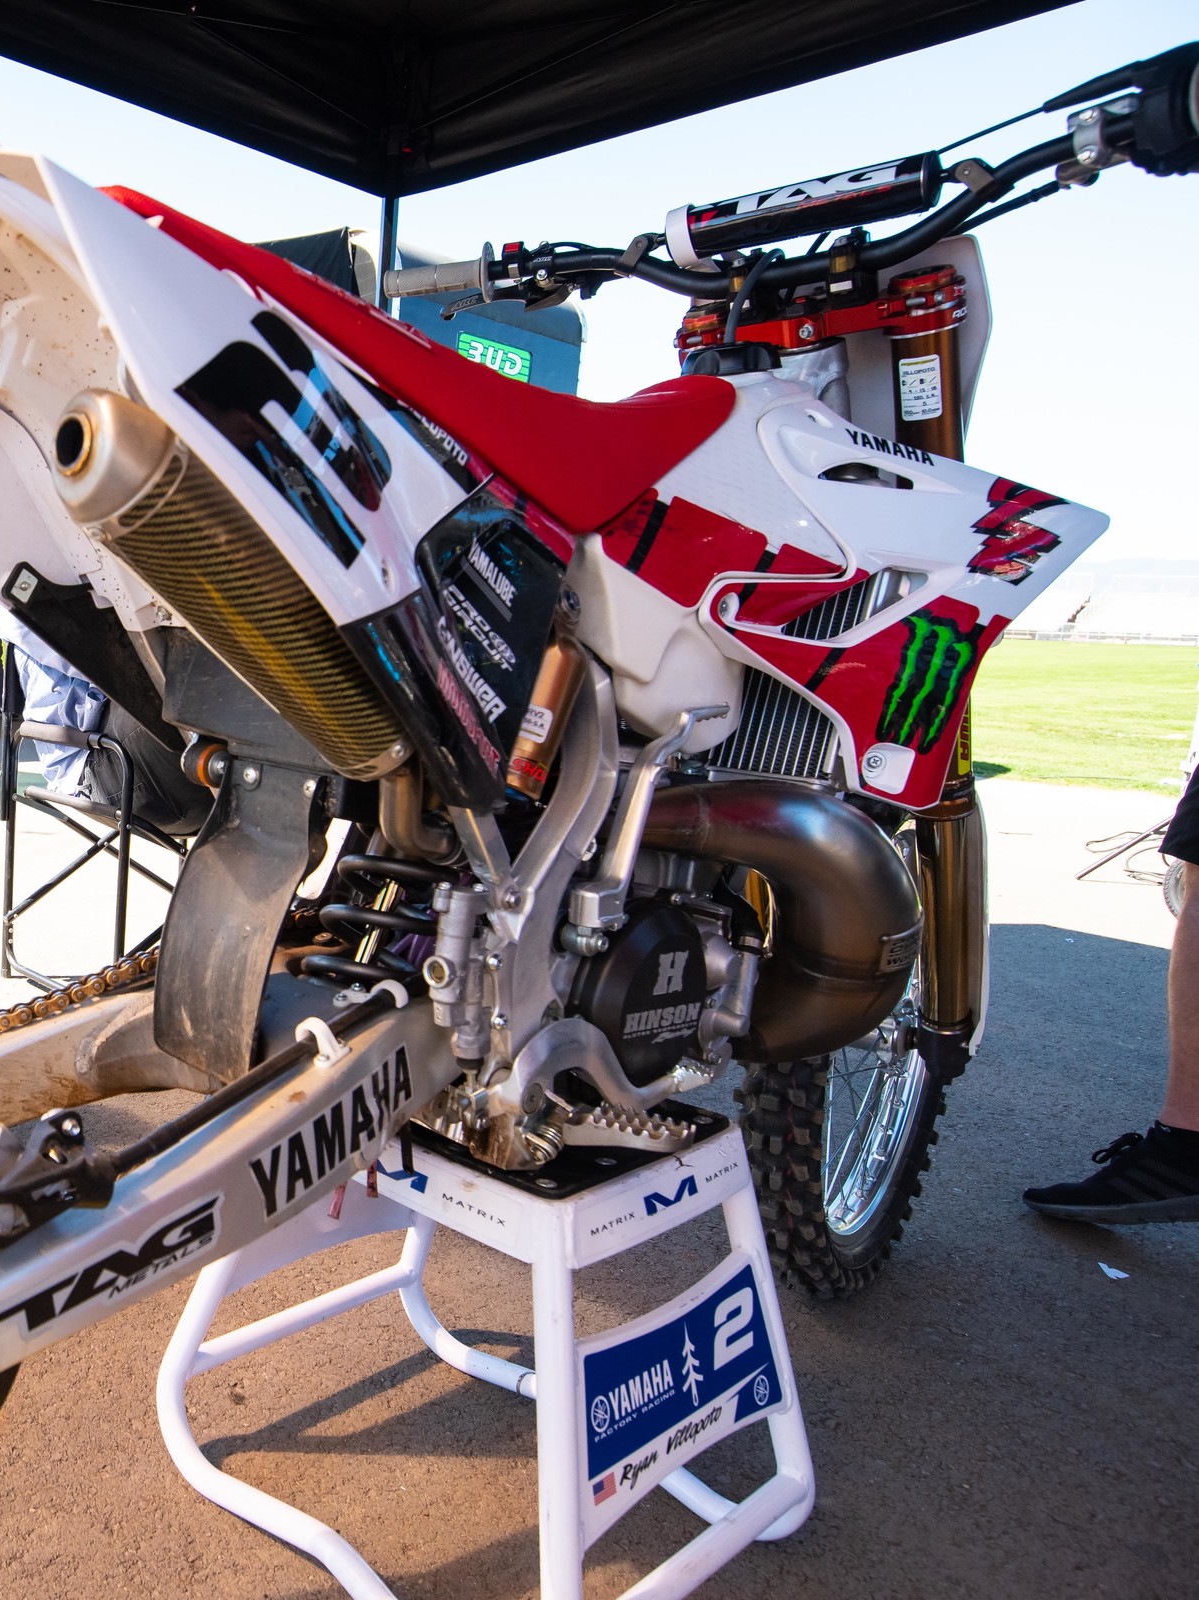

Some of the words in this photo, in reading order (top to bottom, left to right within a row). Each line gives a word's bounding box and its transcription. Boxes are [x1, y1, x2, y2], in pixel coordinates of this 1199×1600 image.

[715, 159, 907, 215] TAG
[173, 310, 394, 570] 2
[845, 427, 935, 467] YAMAHA
[467, 536, 518, 608] YAMALUBE
[623, 1001, 702, 1034] HINSON
[248, 1044, 412, 1218] YAMAHA
[705, 1161, 739, 1184] MATRIX
[441, 1192, 506, 1227] MATRIX
[590, 1211, 636, 1236] MATRIX
[108, 1232, 214, 1300] METALS
[714, 1286, 754, 1371] 2
[594, 1413, 639, 1444] FACTORY
[641, 1389, 676, 1414] RACING
[607, 1359, 675, 1421] YAMAHA
[619, 1449, 659, 1490] Ryan
[666, 1404, 723, 1456] Villopoto
